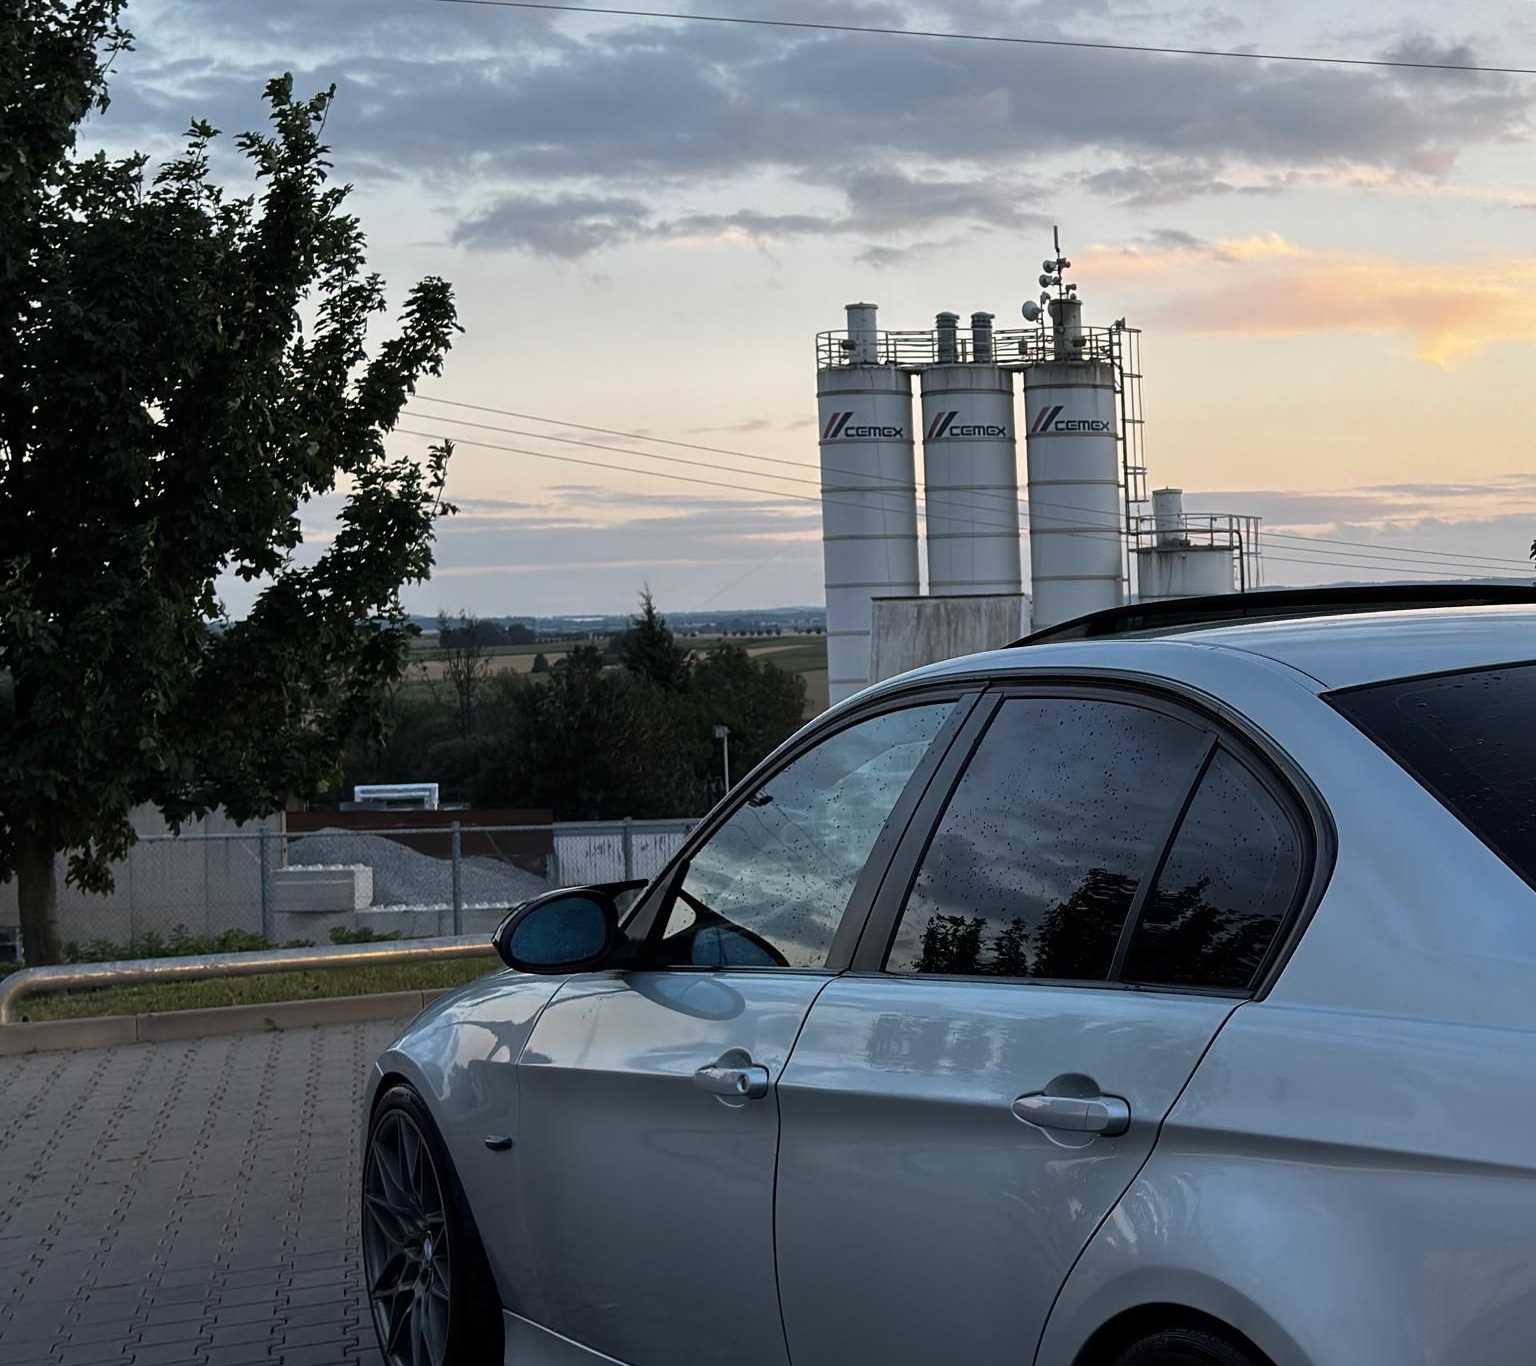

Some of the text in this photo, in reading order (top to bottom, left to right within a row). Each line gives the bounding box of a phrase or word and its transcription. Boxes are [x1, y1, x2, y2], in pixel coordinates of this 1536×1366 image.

[844, 426, 904, 438] CEMEX
[949, 425, 1007, 438] CEMEX
[1054, 419, 1111, 432] CEMEX
